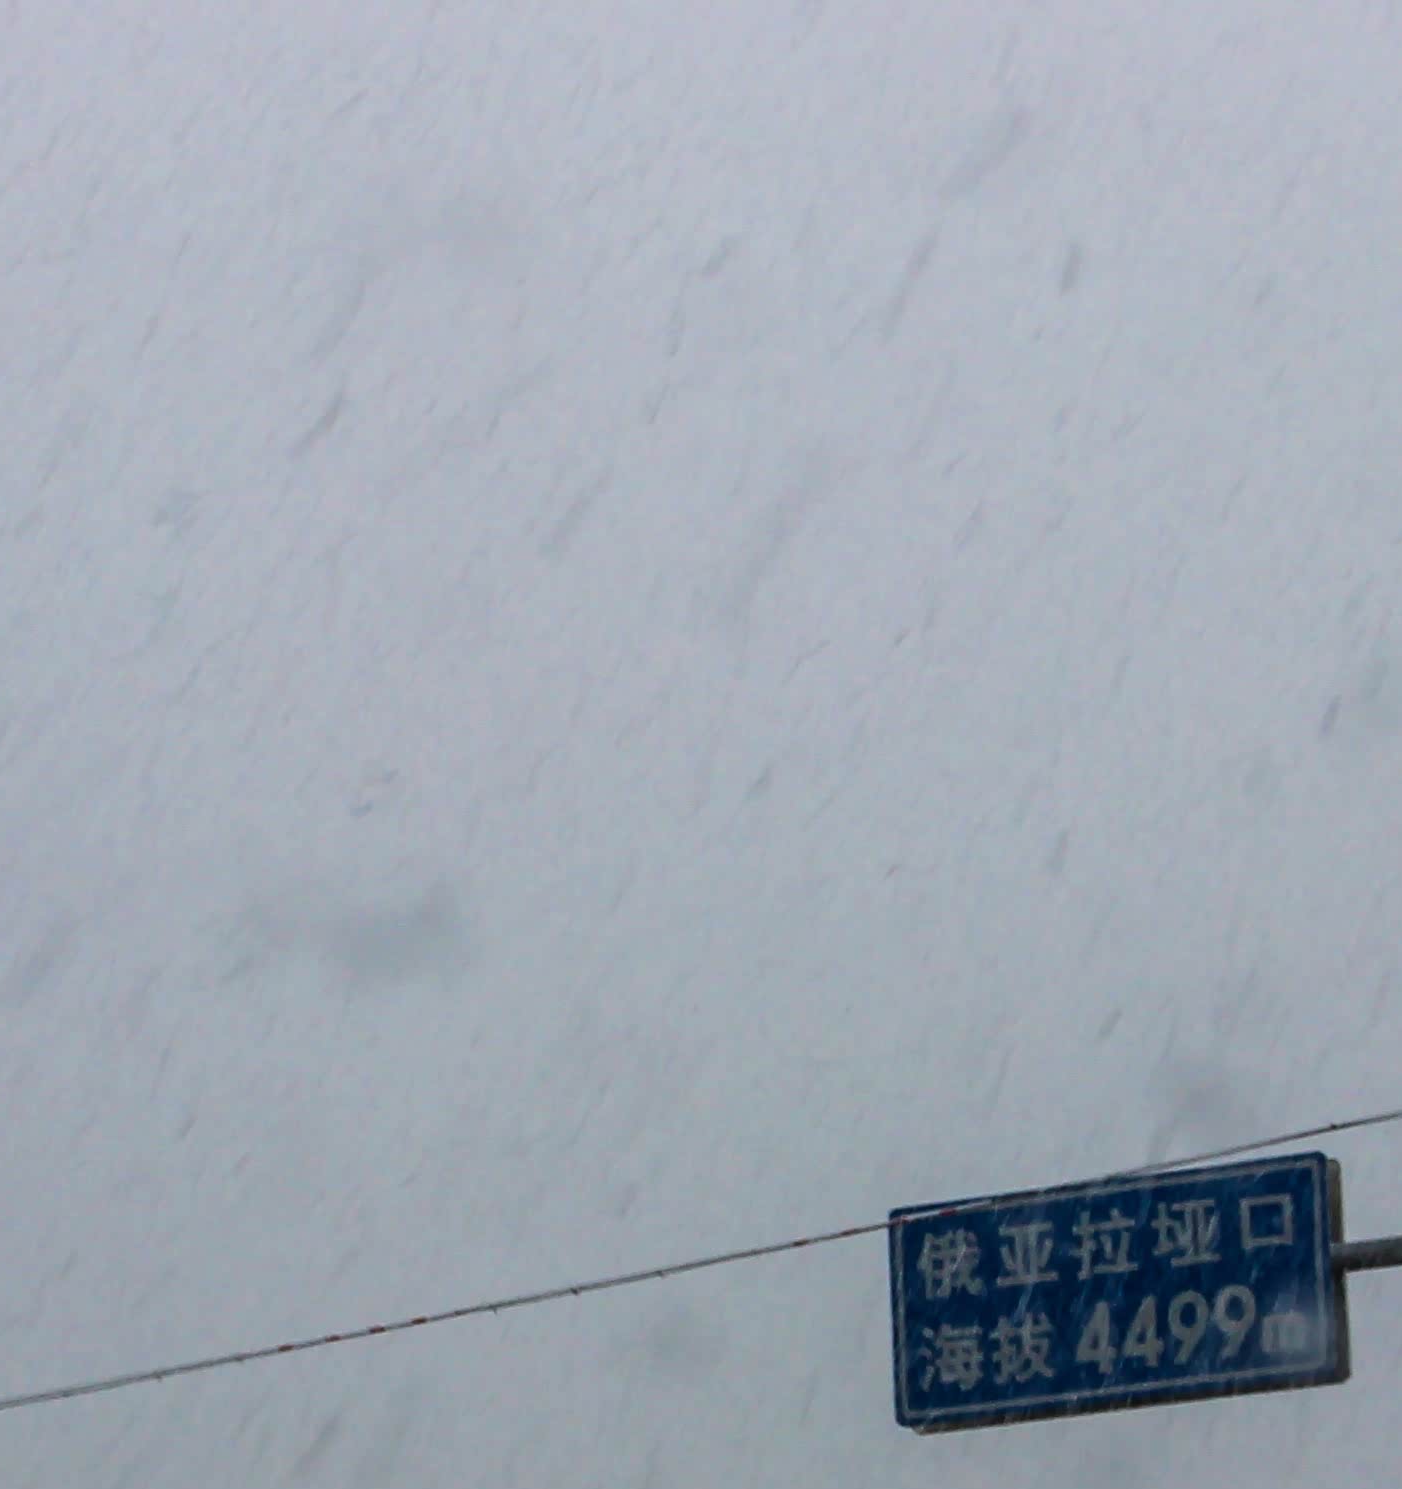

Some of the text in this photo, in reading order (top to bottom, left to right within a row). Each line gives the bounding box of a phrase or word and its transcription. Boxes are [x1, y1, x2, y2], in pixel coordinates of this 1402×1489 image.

[917, 1193, 1295, 1299] 俄亚拉垭口
